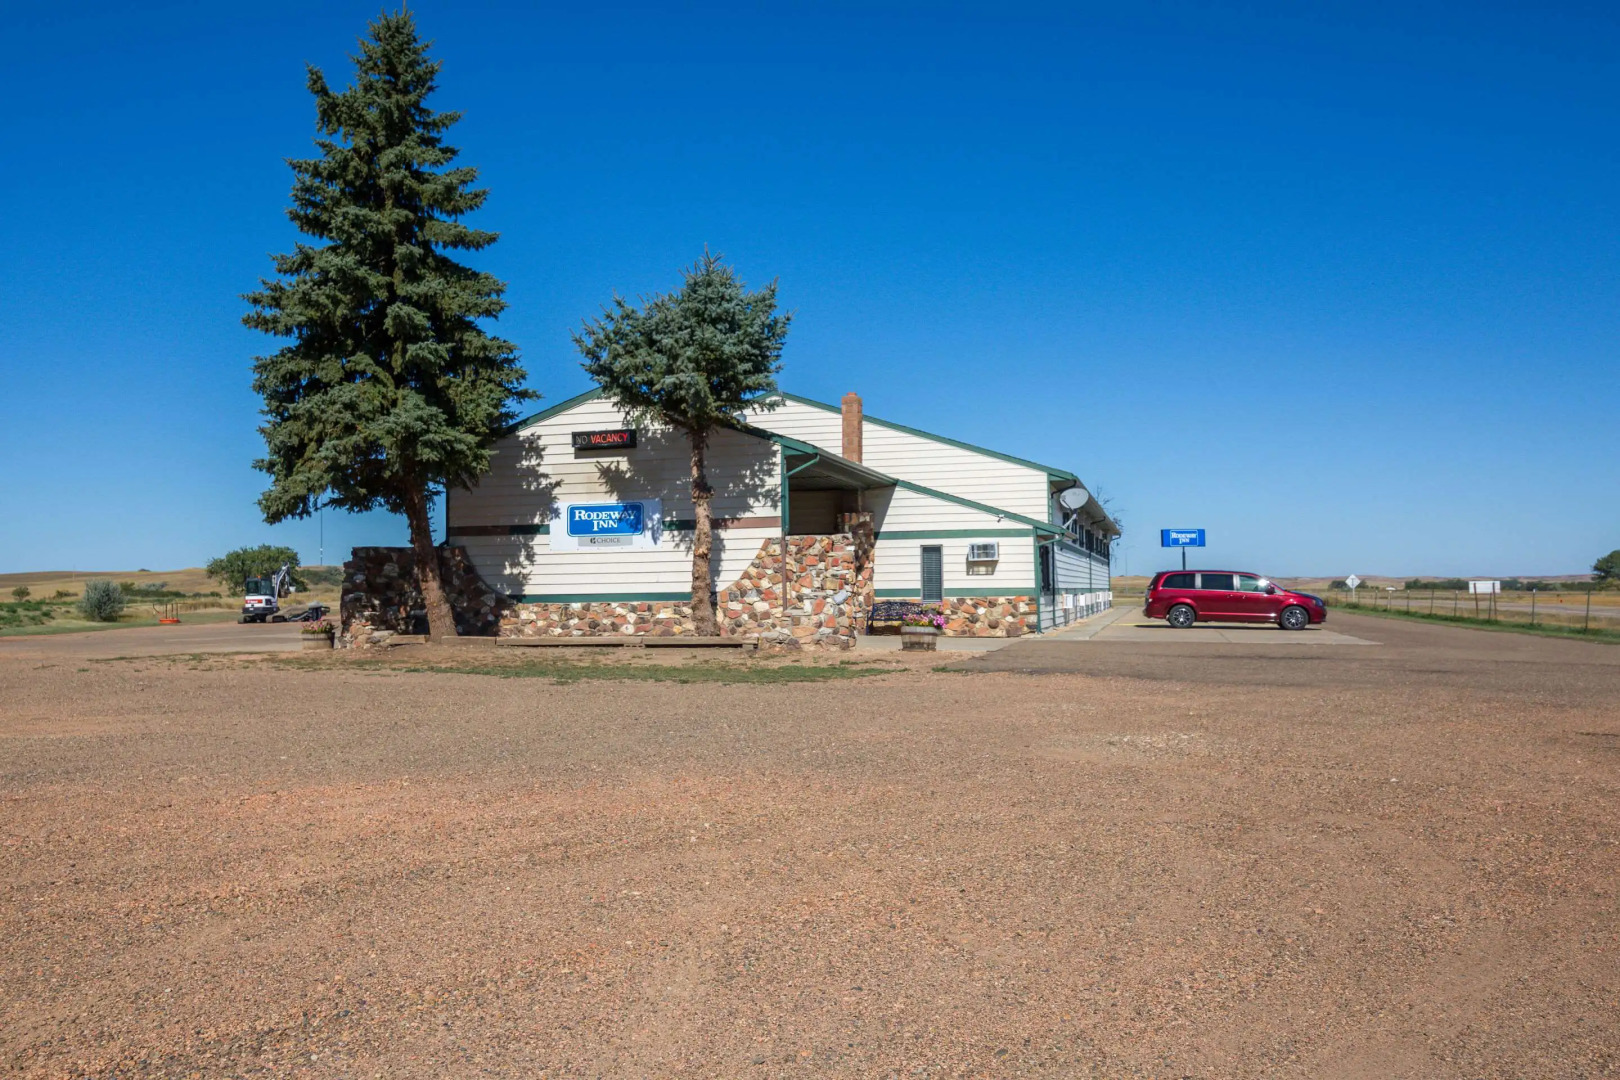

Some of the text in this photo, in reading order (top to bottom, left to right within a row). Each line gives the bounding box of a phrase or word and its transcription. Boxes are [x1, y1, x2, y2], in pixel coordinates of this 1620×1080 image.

[575, 432, 628, 444] NO VACANCY
[574, 509, 636, 521] RODEWAY
[592, 519, 618, 531] INN
